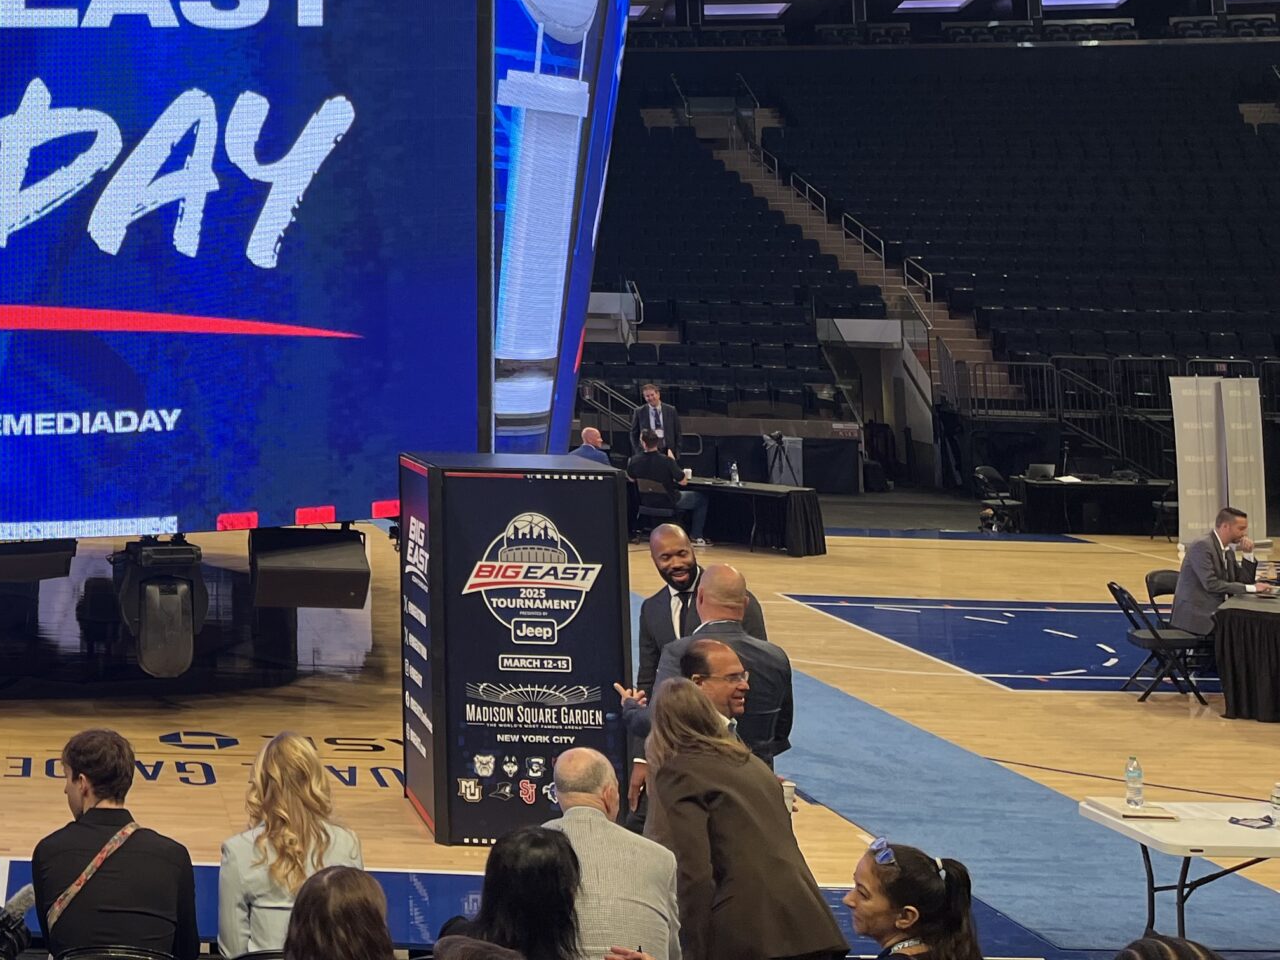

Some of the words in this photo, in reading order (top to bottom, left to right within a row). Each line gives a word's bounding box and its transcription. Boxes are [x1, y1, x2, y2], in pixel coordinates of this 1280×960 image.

[409, 515, 427, 543] BIG
[406, 542, 430, 575] EAST
[519, 589, 546, 599] 2025
[491, 598, 577, 610] TOURNAMENT
[516, 623, 552, 640] Jeep
[503, 658, 540, 668] MARCH
[543, 660, 568, 669] 12-15
[466, 704, 514, 723] MADISON
[517, 705, 558, 724] SQUARE
[560, 706, 603, 725] GARDEN
[497, 734, 520, 742] NEW
[521, 735, 550, 743] YORK
[552, 736, 575, 744] CITY
